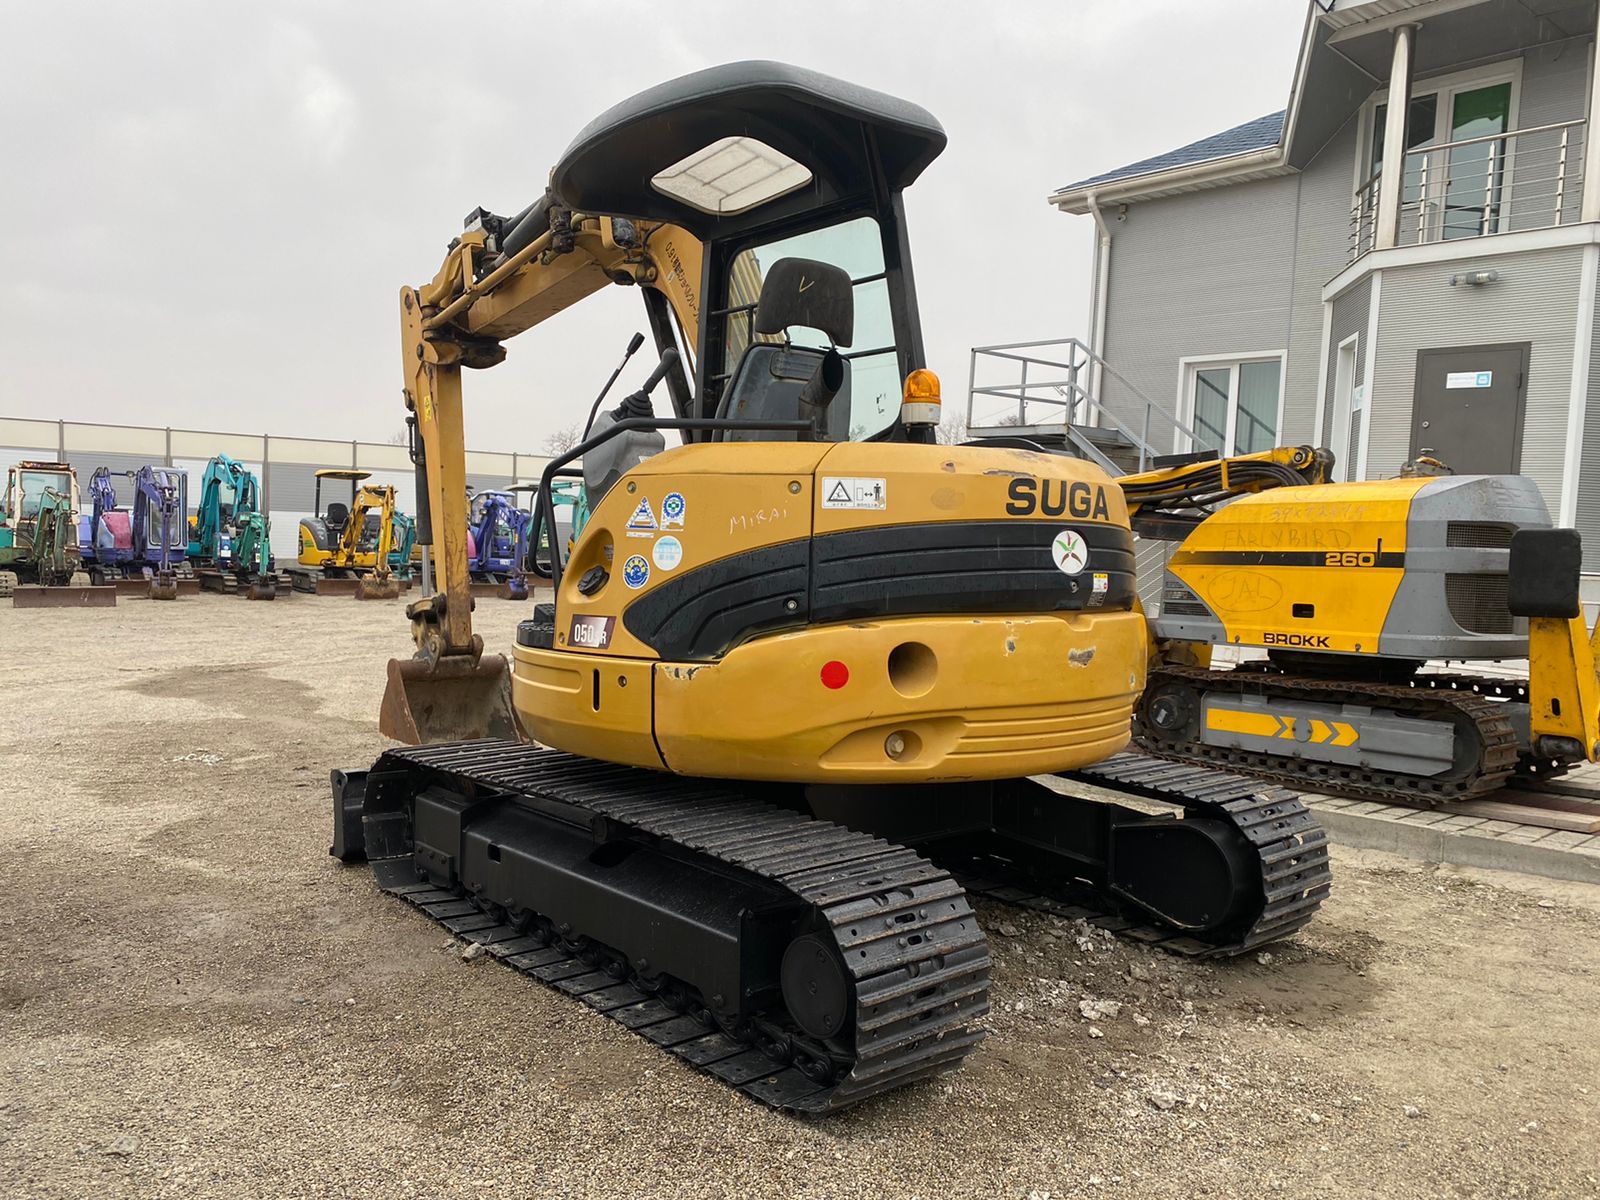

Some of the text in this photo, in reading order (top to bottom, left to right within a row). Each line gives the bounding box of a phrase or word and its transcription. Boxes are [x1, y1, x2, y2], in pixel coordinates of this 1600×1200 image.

[1005, 478, 1110, 521] SUGA
[1325, 552, 1375, 567] 260
[1263, 632, 1330, 648] BROKK
